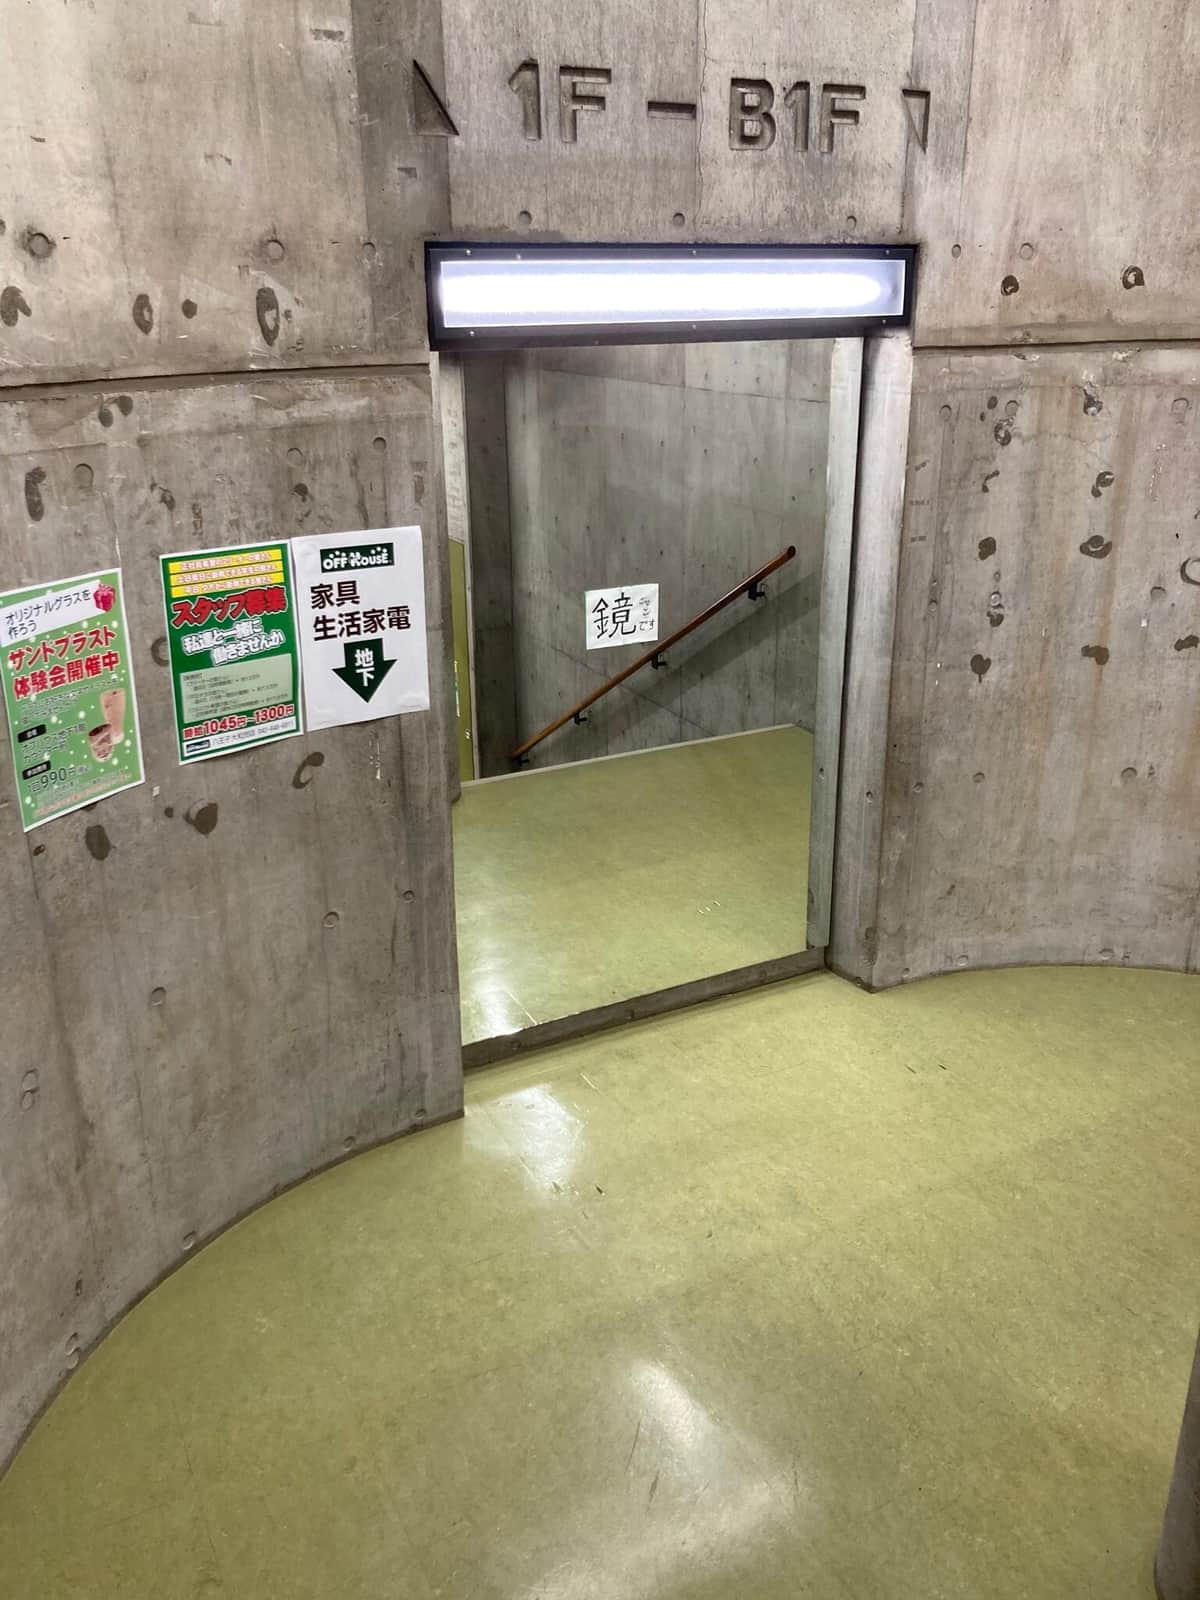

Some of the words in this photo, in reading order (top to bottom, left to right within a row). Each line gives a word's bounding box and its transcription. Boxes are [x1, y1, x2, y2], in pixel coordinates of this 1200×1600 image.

[508, 57, 612, 143] 1F
[729, 77, 866, 154] B1F
[322, 554, 348, 570] OFF
[350, 550, 389, 567] HOUSE
[5, 589, 92, 625] オリジナルグラスを
[170, 585, 287, 629] スタッフ募集
[310, 580, 360, 610] 家具
[8, 619, 38, 640] 作ろう
[313, 605, 411, 641] 生活家電
[591, 592, 637, 639] 鏡
[8, 625, 117, 671] サンドブラスト
[354, 647, 375, 687] 地下
[14, 651, 119, 700] 体験会開催中
